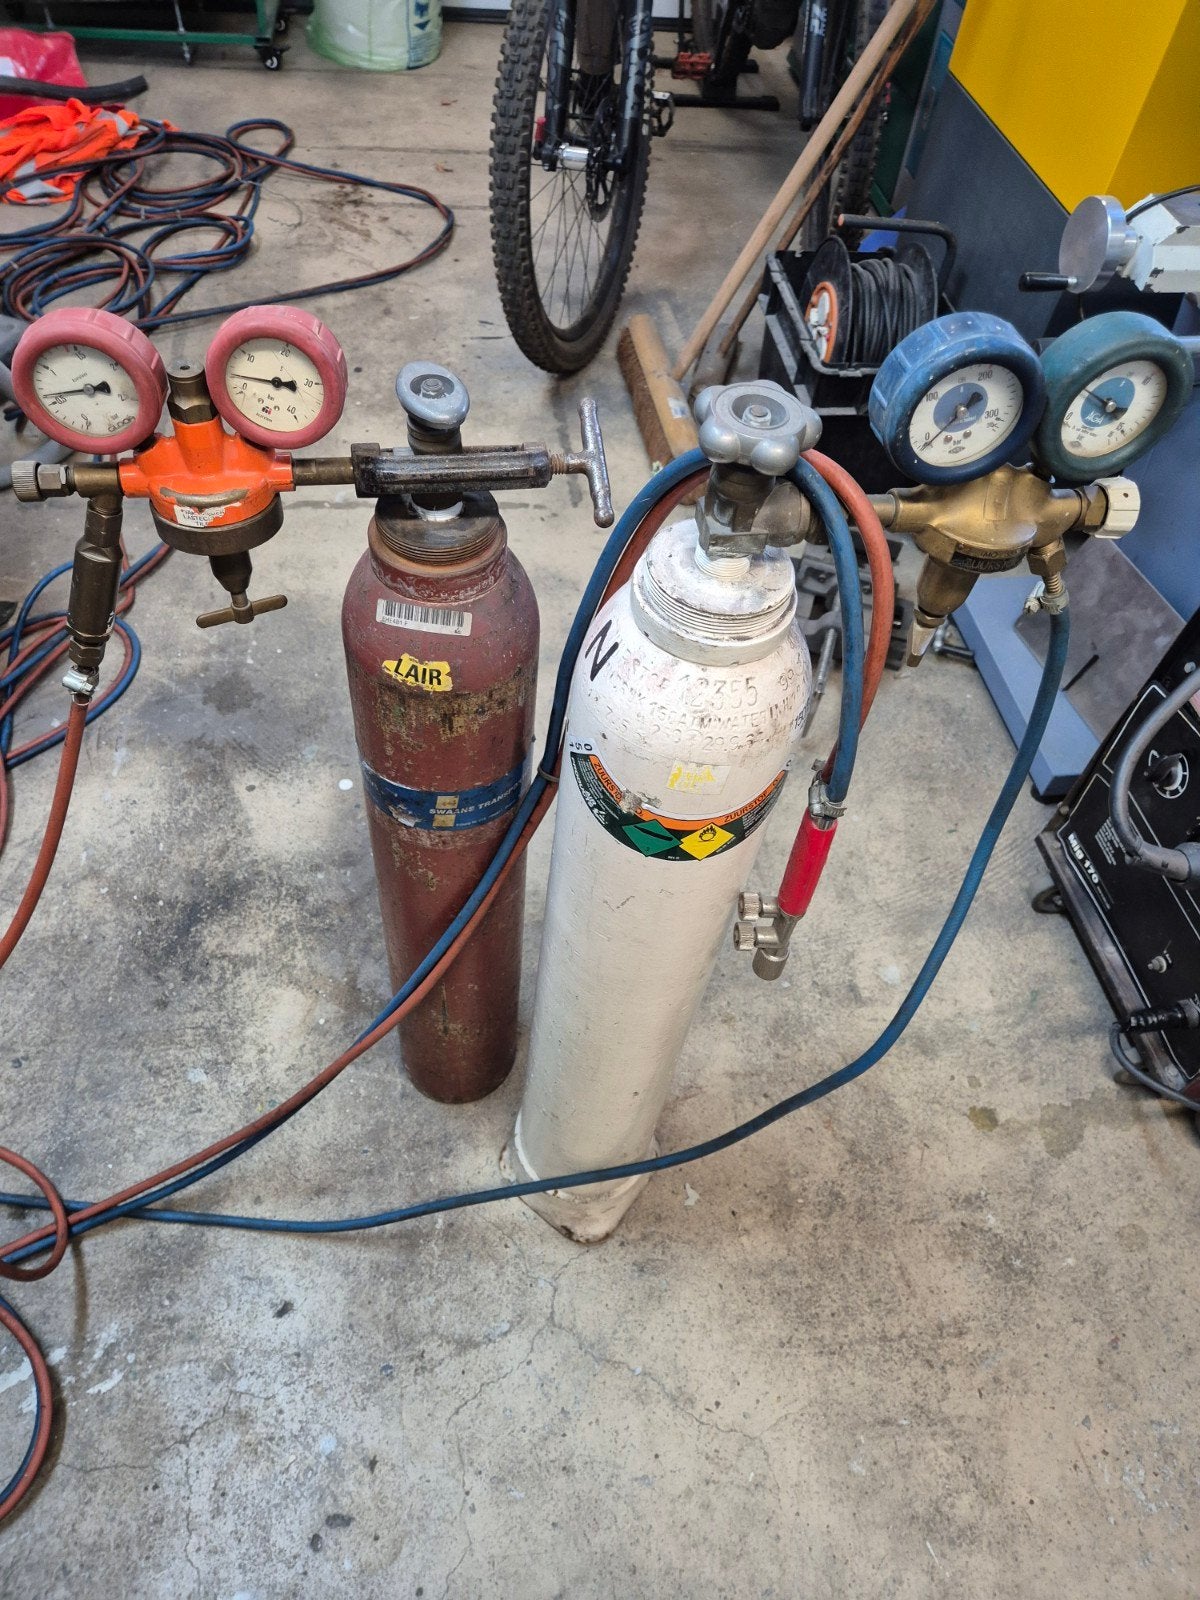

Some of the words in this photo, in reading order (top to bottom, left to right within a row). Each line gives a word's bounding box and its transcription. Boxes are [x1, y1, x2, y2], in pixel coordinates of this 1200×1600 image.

[280, 347, 291, 358] 20
[246, 353, 255, 364] 10
[978, 369, 993, 381] 200
[242, 382, 248, 391] 0
[303, 378, 314, 388] 30
[925, 391, 939, 402] 100
[286, 405, 297, 415] 40
[984, 408, 999, 419] 300
[925, 432, 930, 441] 0
[1084, 859, 1099, 884] 170
